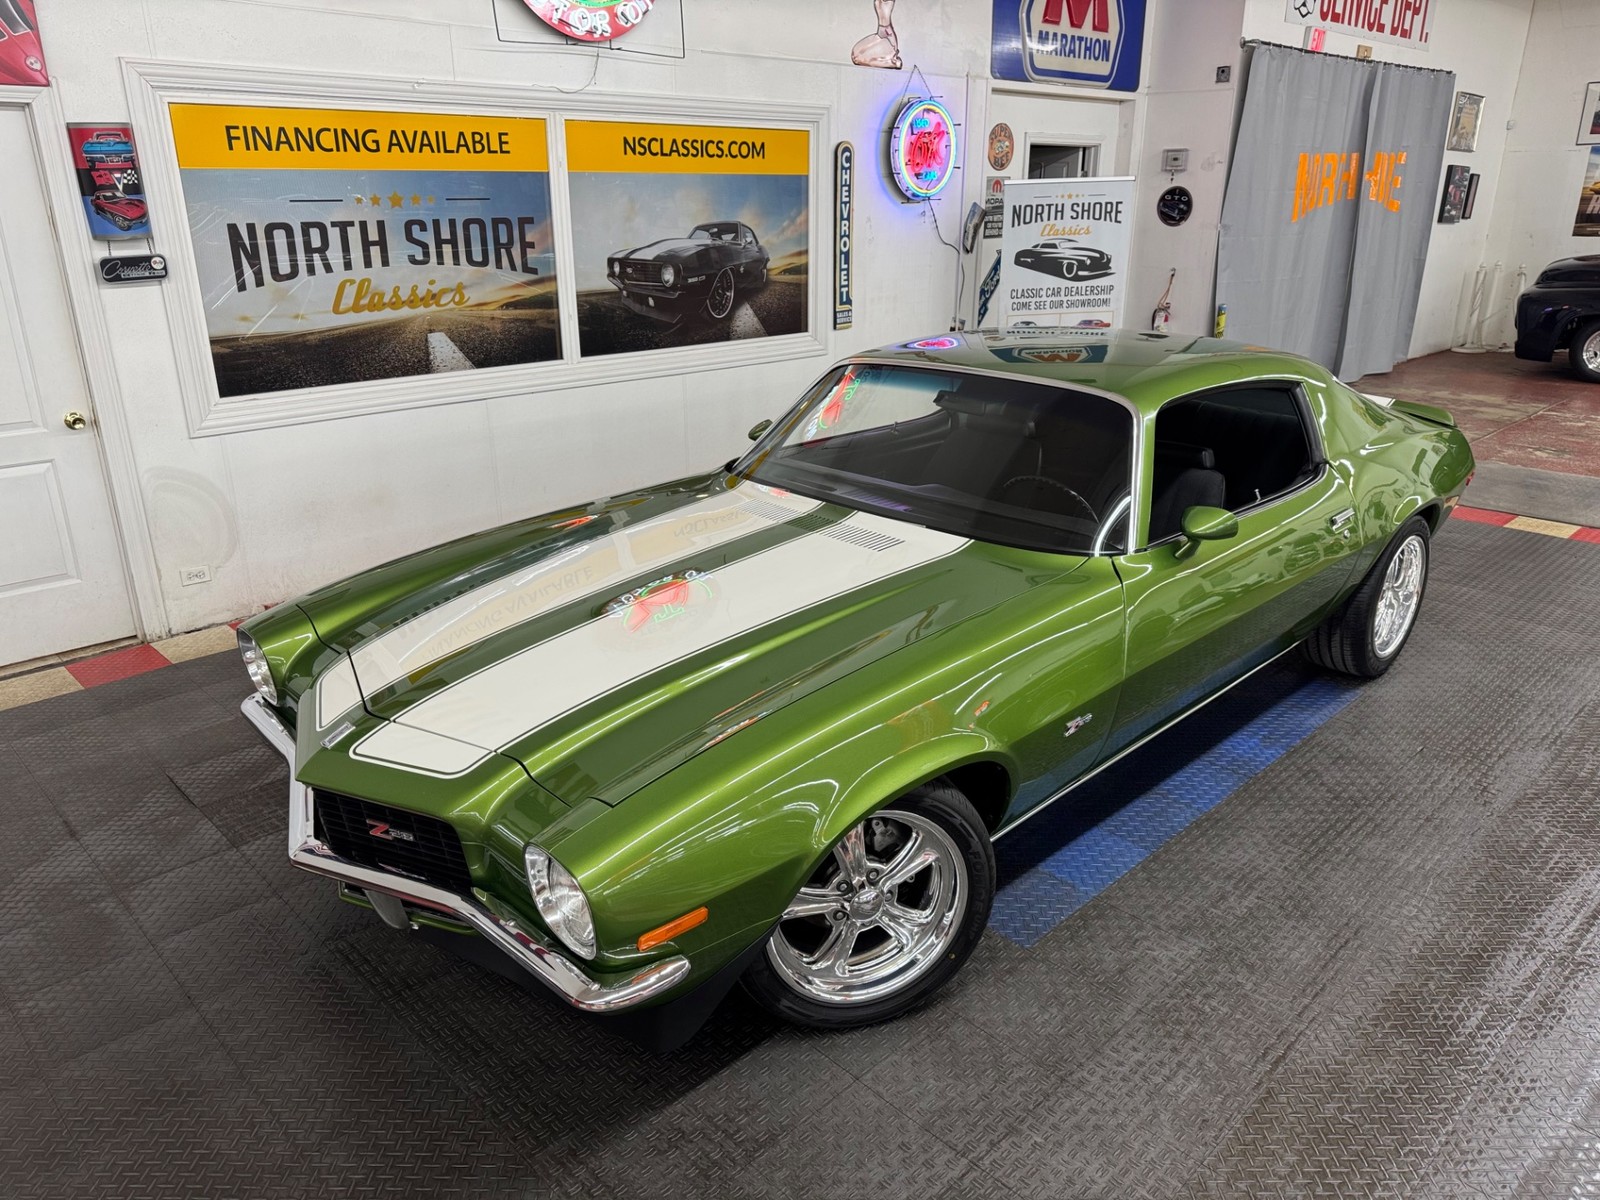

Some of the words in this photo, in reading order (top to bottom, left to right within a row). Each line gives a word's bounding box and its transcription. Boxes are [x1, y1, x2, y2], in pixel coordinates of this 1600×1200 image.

[1038, 30, 1111, 62] MARATHON
[225, 124, 381, 154] FINANCING
[387, 128, 511, 155] AVAILABLE
[623, 136, 766, 160] NSCLASSICS.COM
[986, 197, 1003, 205] MOPA
[1164, 194, 1189, 202] GTO
[840, 151, 851, 302] CHEVROLET
[1011, 203, 1065, 229] NORTH
[1070, 201, 1123, 225] SHORE
[1040, 224, 1092, 237] Classics
[226, 219, 390, 292] NORTH
[404, 216, 538, 277] SHORE
[331, 278, 470, 315] Classics
[1010, 288, 1043, 300] CLASSIC
[1046, 287, 1062, 298] CAR
[1064, 285, 1115, 297] DEALERSHIP
[1011, 301, 1032, 311] COME
[1034, 300, 1047, 311] SEE
[1050, 300, 1064, 310] OUR
[1066, 298, 1111, 310] SHOWROOM!
